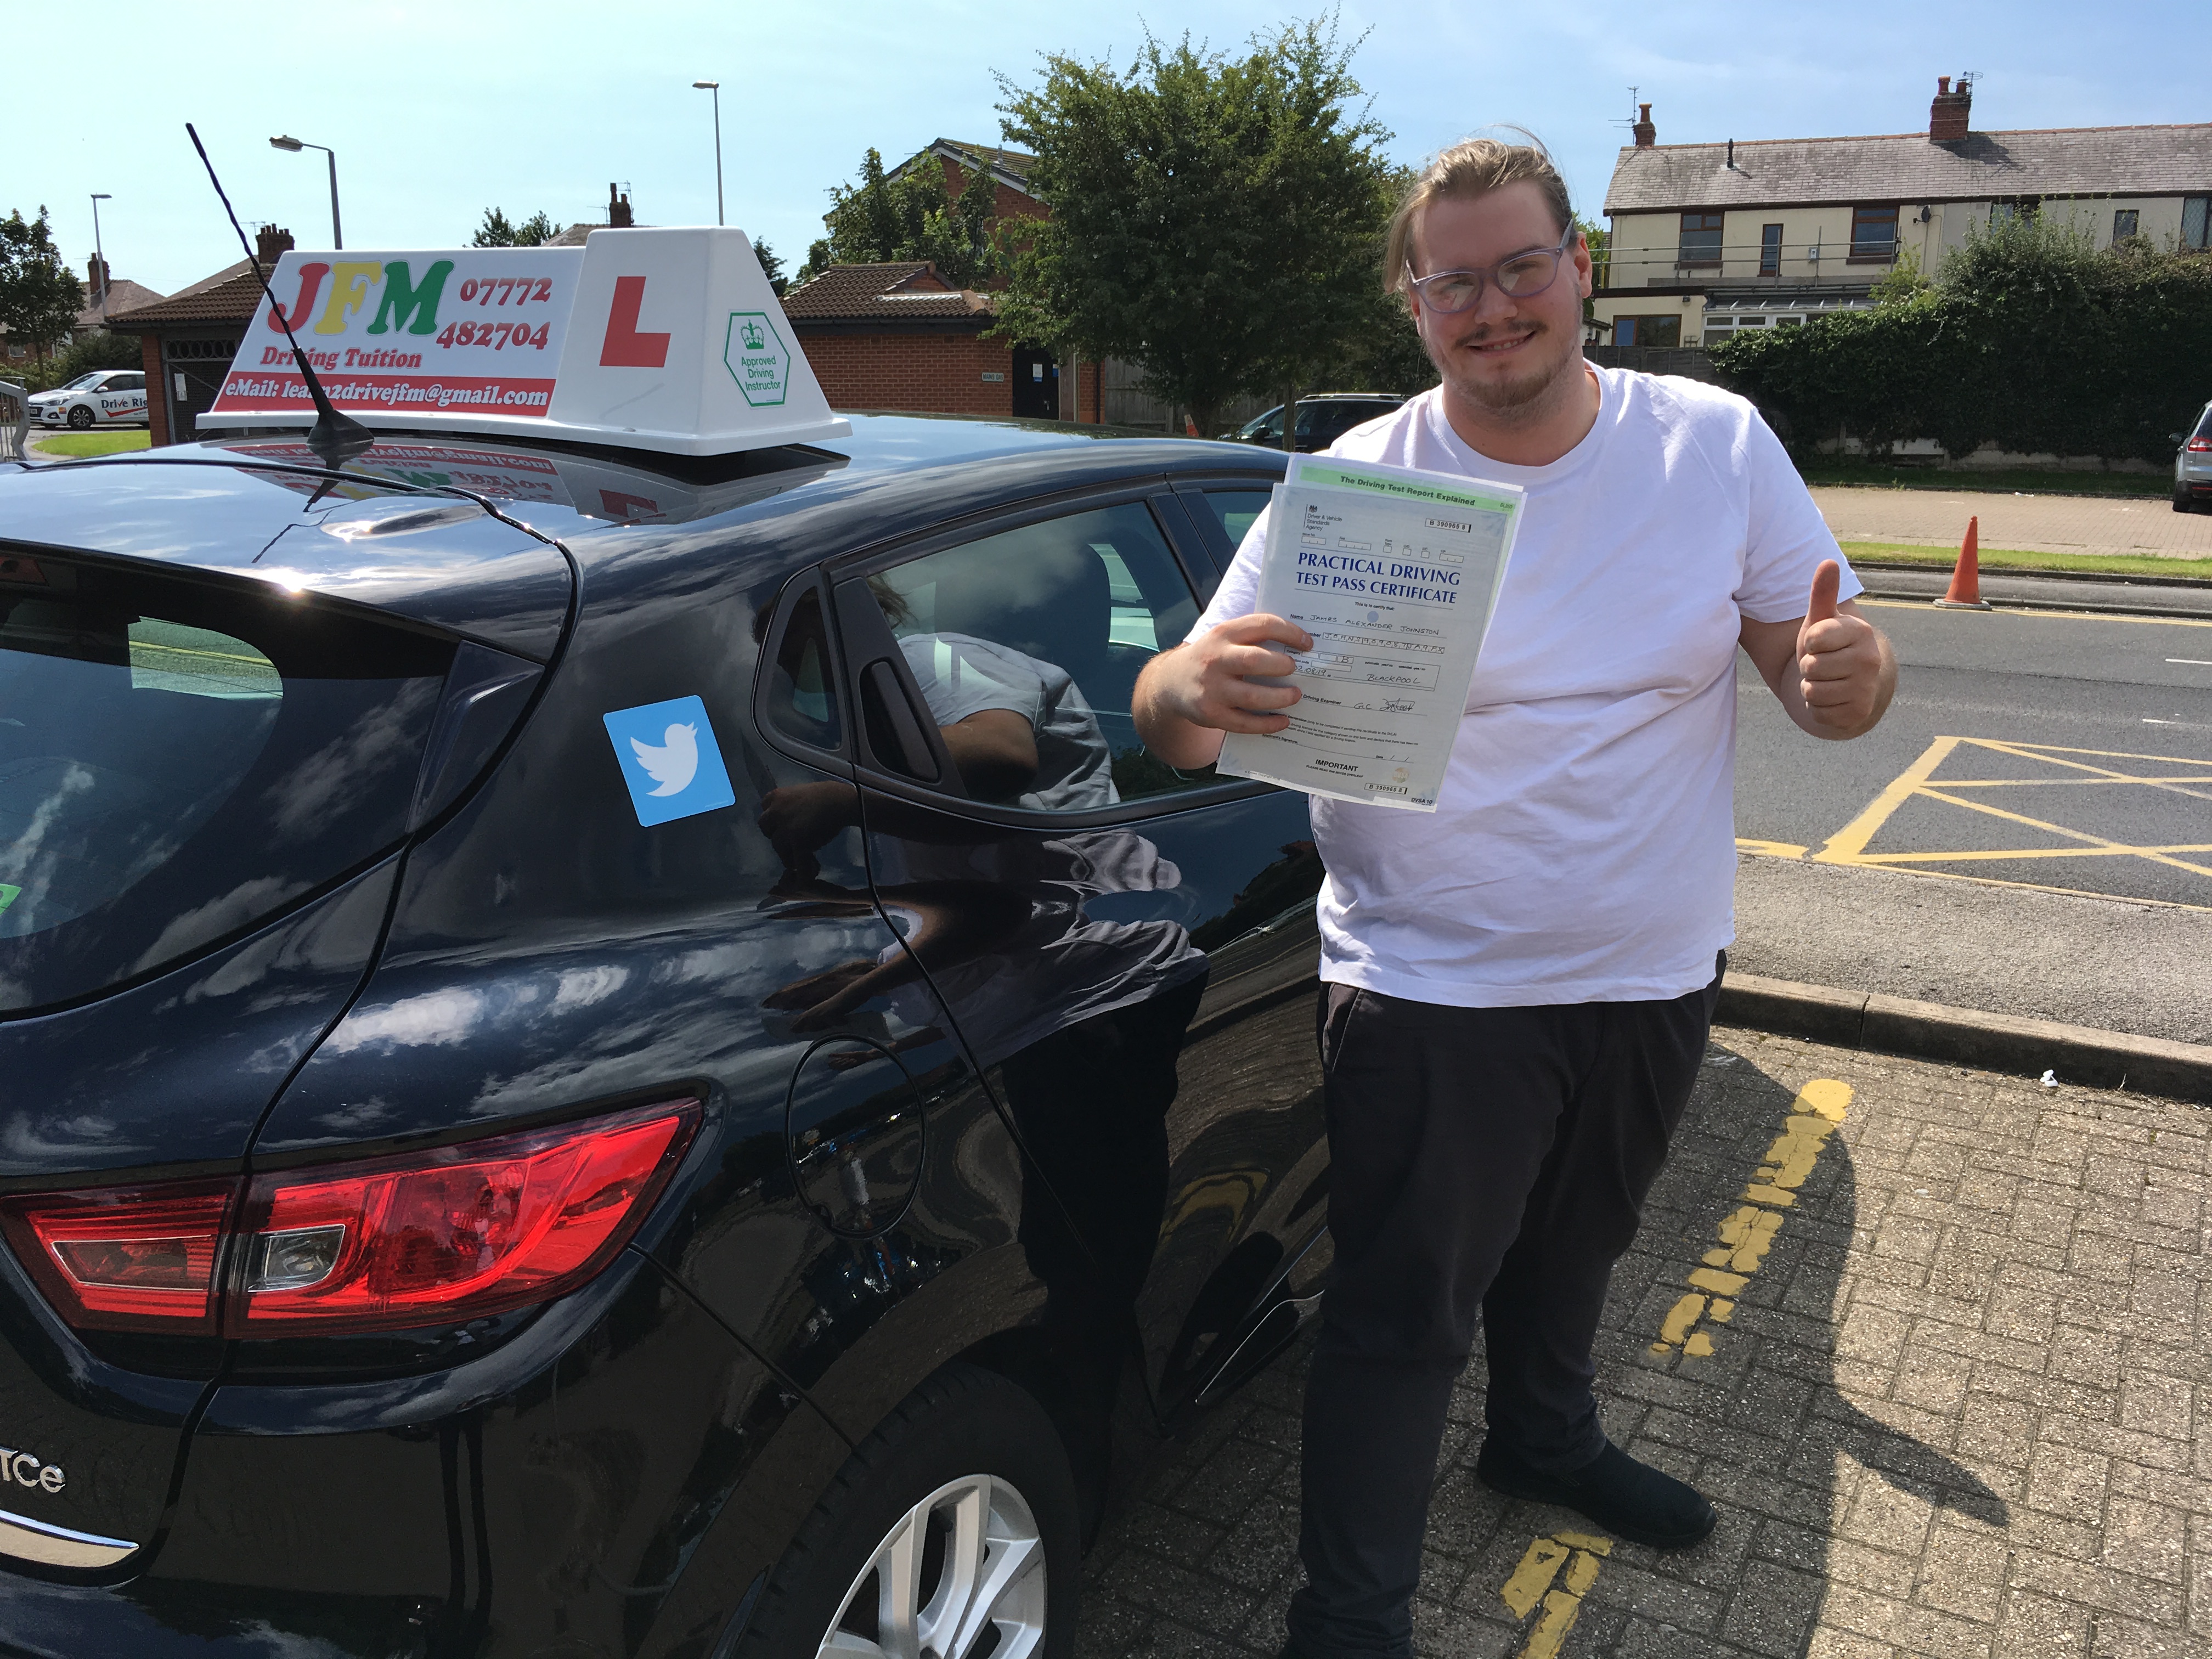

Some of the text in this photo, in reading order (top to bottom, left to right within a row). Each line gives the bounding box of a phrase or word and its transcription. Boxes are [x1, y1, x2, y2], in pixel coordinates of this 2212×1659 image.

[268, 259, 455, 336] JFM
[460, 277, 552, 306] 07772
[600, 276, 671, 368] L
[436, 320, 551, 351] 482704
[260, 346, 422, 371] Driing Tuition
[742, 356, 776, 368] Approved
[745, 381, 781, 391] Instructor
[748, 368, 774, 379] Driving
[101, 397, 128, 409] Drive
[225, 379, 549, 407] eMail: lean2drivejfm@gmail.com
[1358, 479, 1385, 490] Driving
[1388, 484, 1404, 492] Test
[1407, 487, 1434, 498] Report
[1436, 493, 1476, 506] Explained
[1298, 552, 1461, 586] PRACTICAL DRIVING
[1296, 572, 1458, 604] TEST PASS CERTIFICATE
[1345, 619, 1393, 630] ALEXANDER
[1400, 626, 1439, 635] JOHNSTON
[1367, 674, 1420, 684] BLACKPOOL
[1302, 694, 1319, 702] Driving
[1316, 759, 1358, 772] IMPORTANT
